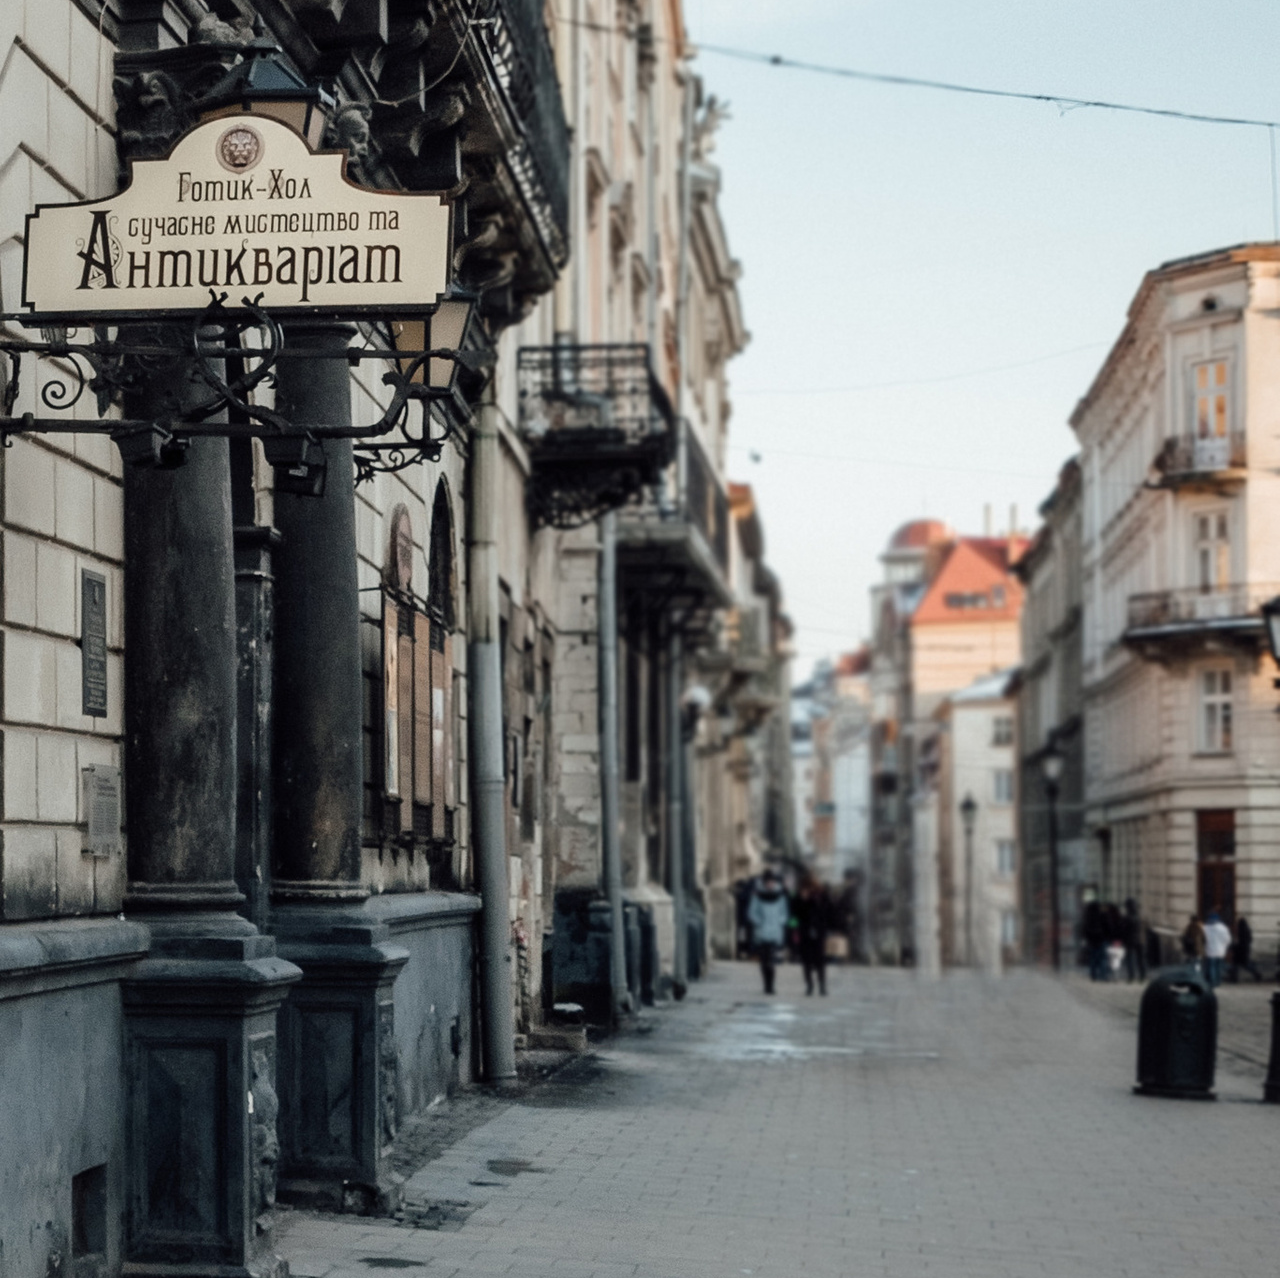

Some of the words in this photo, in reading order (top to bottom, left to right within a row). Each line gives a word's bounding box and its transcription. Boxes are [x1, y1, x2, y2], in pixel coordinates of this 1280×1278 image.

[177, 168, 312, 202] Готик-Хол
[128, 215, 215, 245] сучасне
[223, 211, 360, 238] мистецтво
[368, 210, 400, 230] та
[75, 210, 403, 302] Антикваріат
